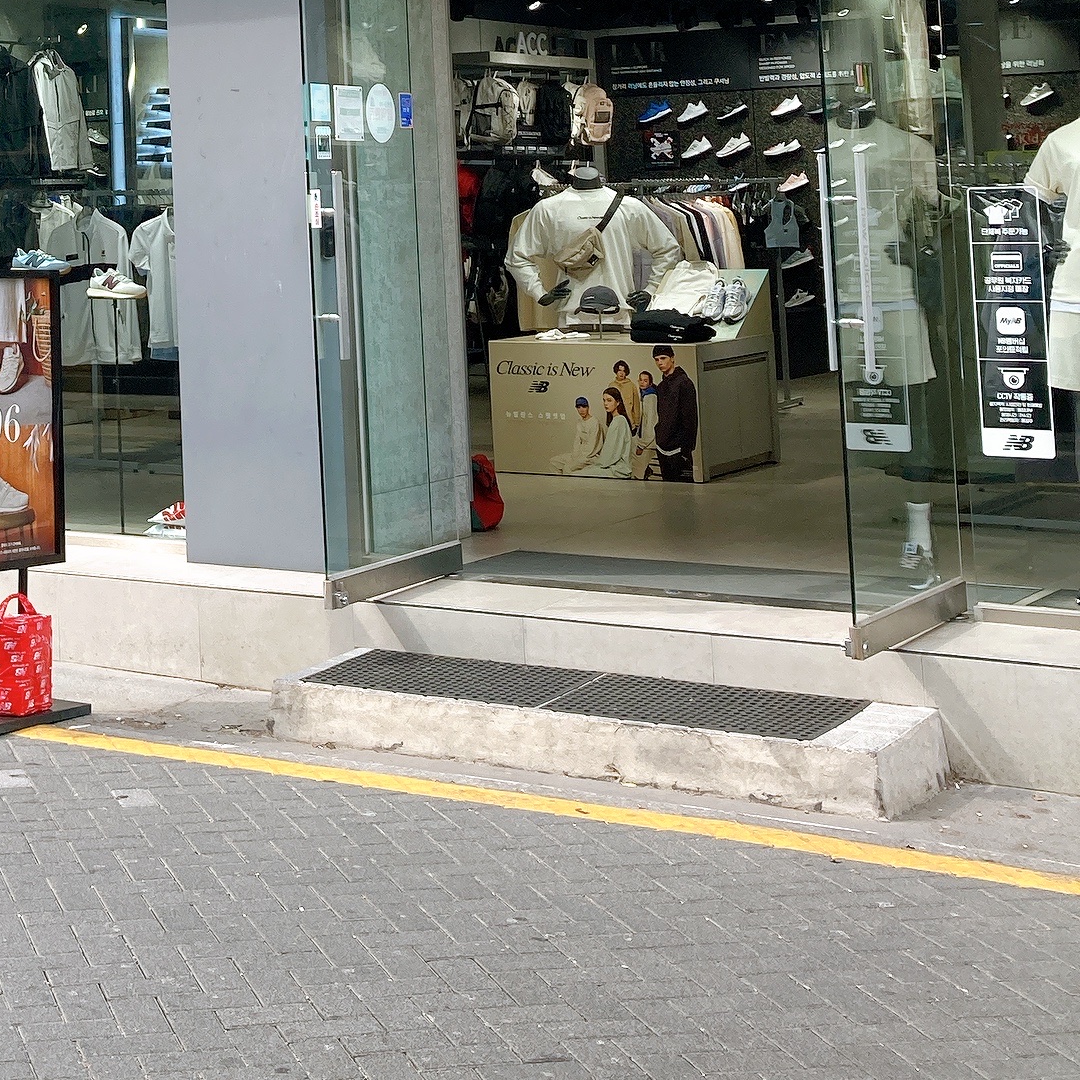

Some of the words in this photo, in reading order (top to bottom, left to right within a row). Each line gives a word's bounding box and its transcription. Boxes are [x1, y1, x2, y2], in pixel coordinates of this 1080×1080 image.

[516, 31, 548, 56] ACC
[496, 360, 545, 377] Classic
[546, 362, 559, 377] is
[560, 362, 596, 377] New
